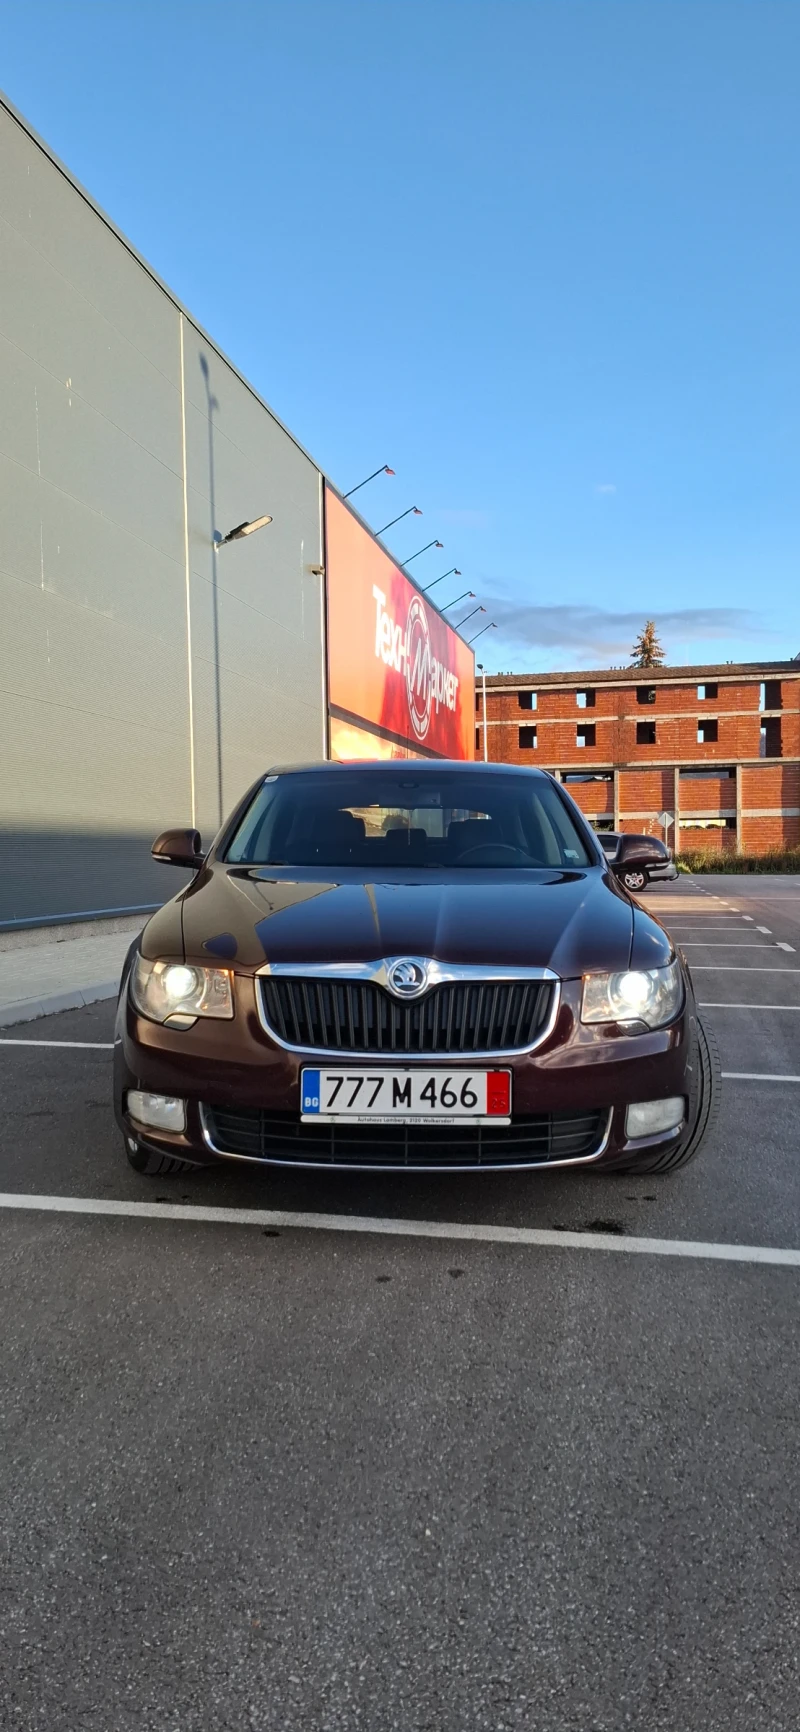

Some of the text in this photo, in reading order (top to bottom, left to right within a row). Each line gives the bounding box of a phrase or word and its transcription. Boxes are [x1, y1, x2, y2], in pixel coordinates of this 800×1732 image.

[304, 1096, 319, 1107] BG
[326, 1076, 478, 1108] 777 M 466
